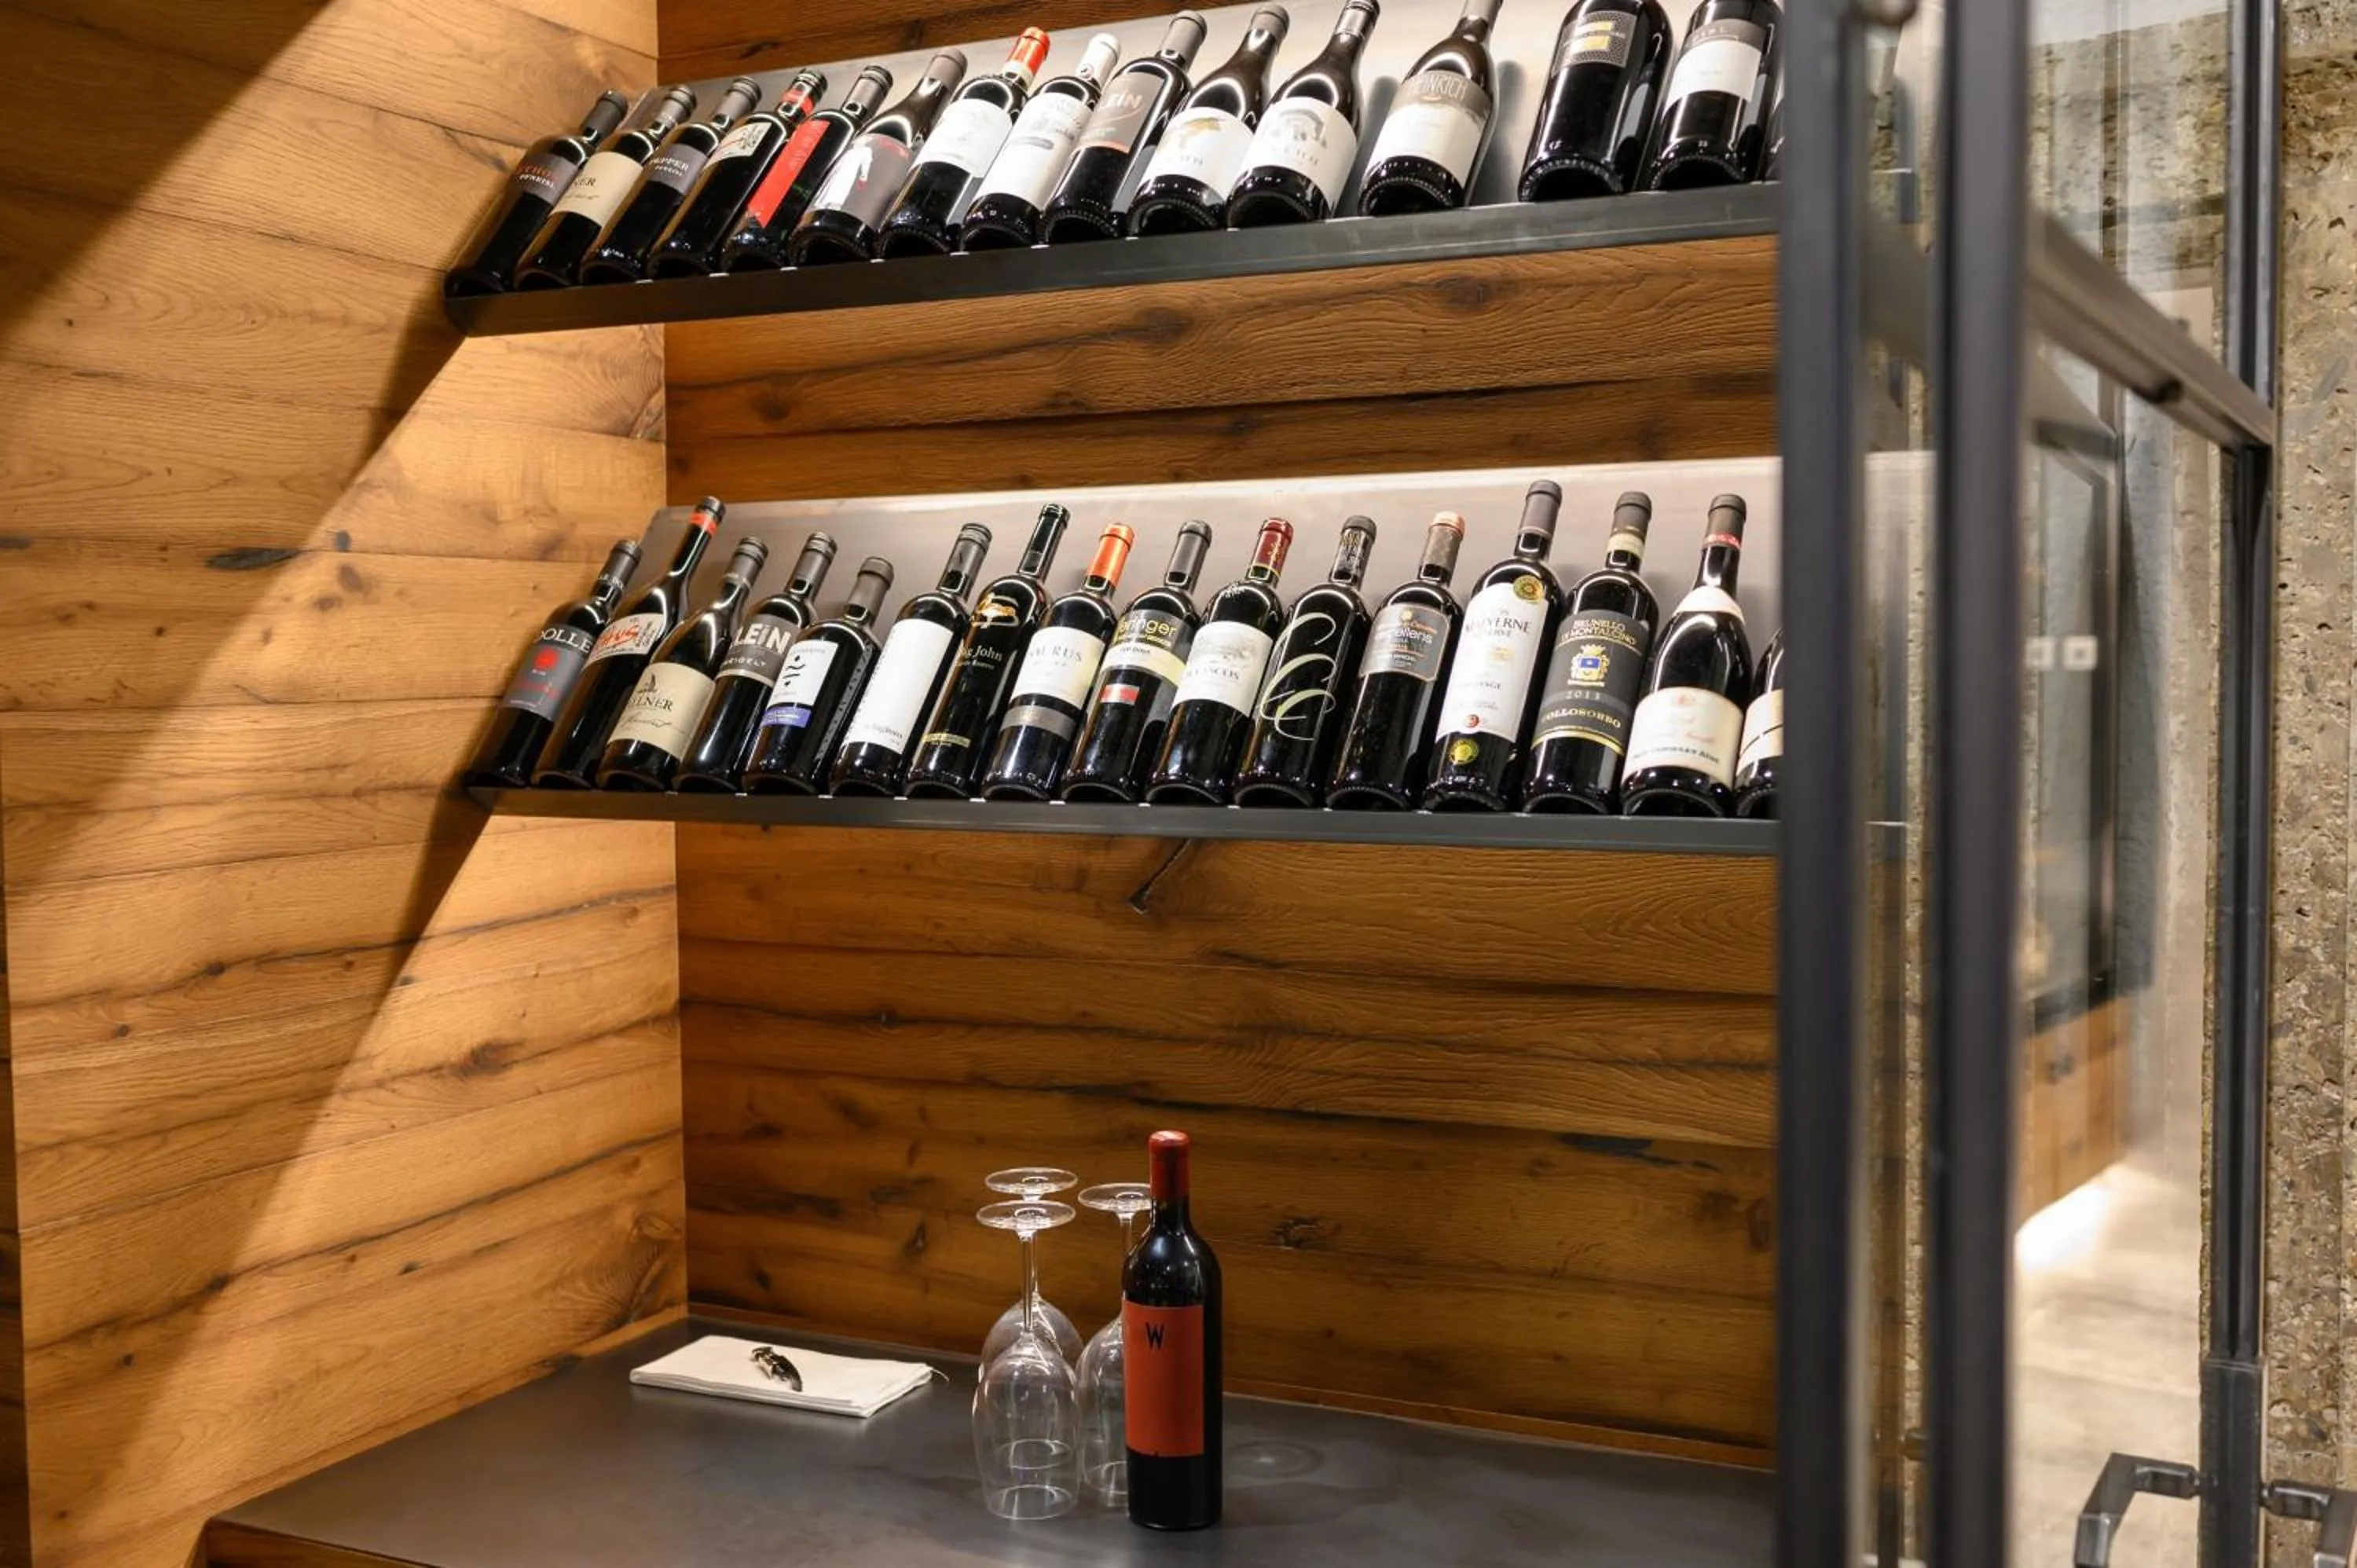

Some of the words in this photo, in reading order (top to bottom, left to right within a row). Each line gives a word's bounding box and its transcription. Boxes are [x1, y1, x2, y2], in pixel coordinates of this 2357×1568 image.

[1574, 618, 1626, 632] BRUNELLO
[972, 645, 1003, 662] John
[1541, 708, 1621, 728] OLLOSORBO
[1145, 1321, 1165, 1351] W
